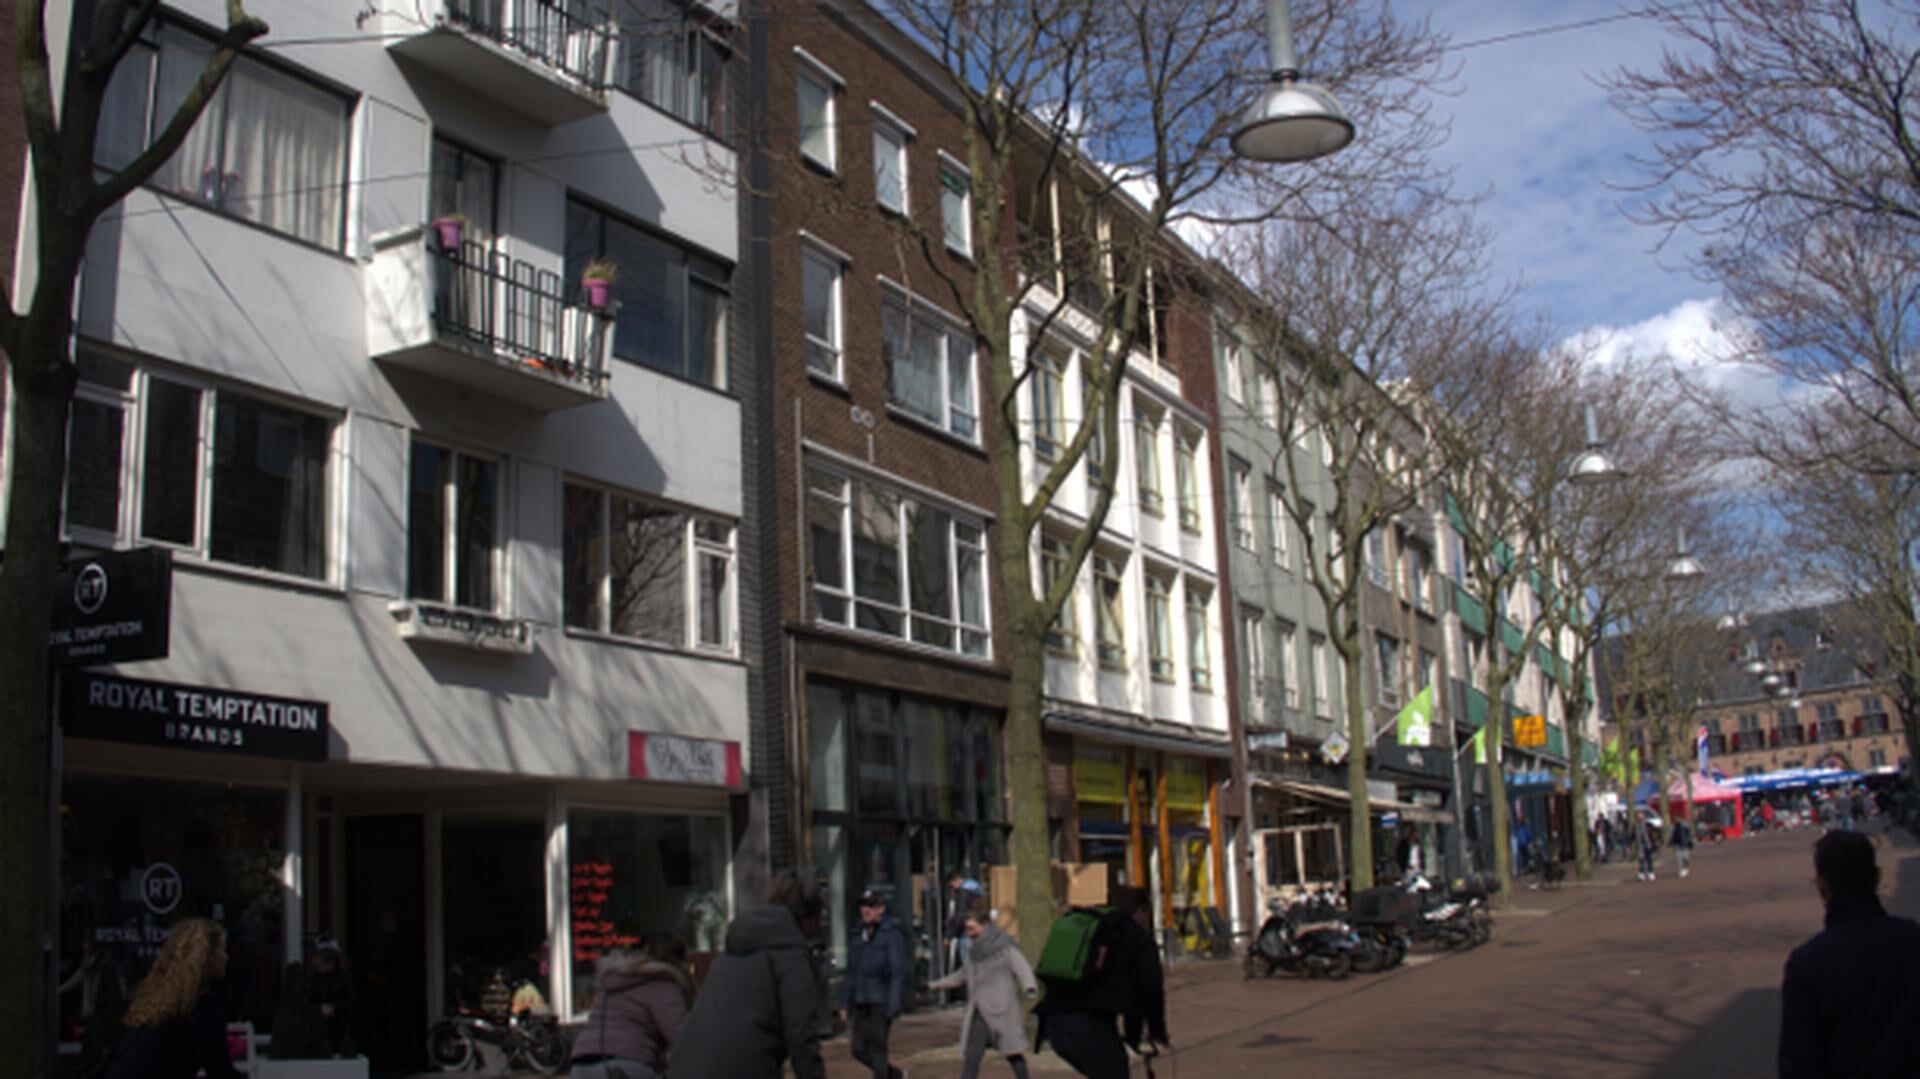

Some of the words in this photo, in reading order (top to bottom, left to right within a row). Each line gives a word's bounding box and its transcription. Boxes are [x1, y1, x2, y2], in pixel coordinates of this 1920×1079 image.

[89, 680, 169, 714] ROYAL
[174, 691, 318, 731] TEMPTATION
[165, 723, 243, 747] BRANDS
[149, 877, 176, 898] RT
[95, 927, 140, 943] ROYAL
